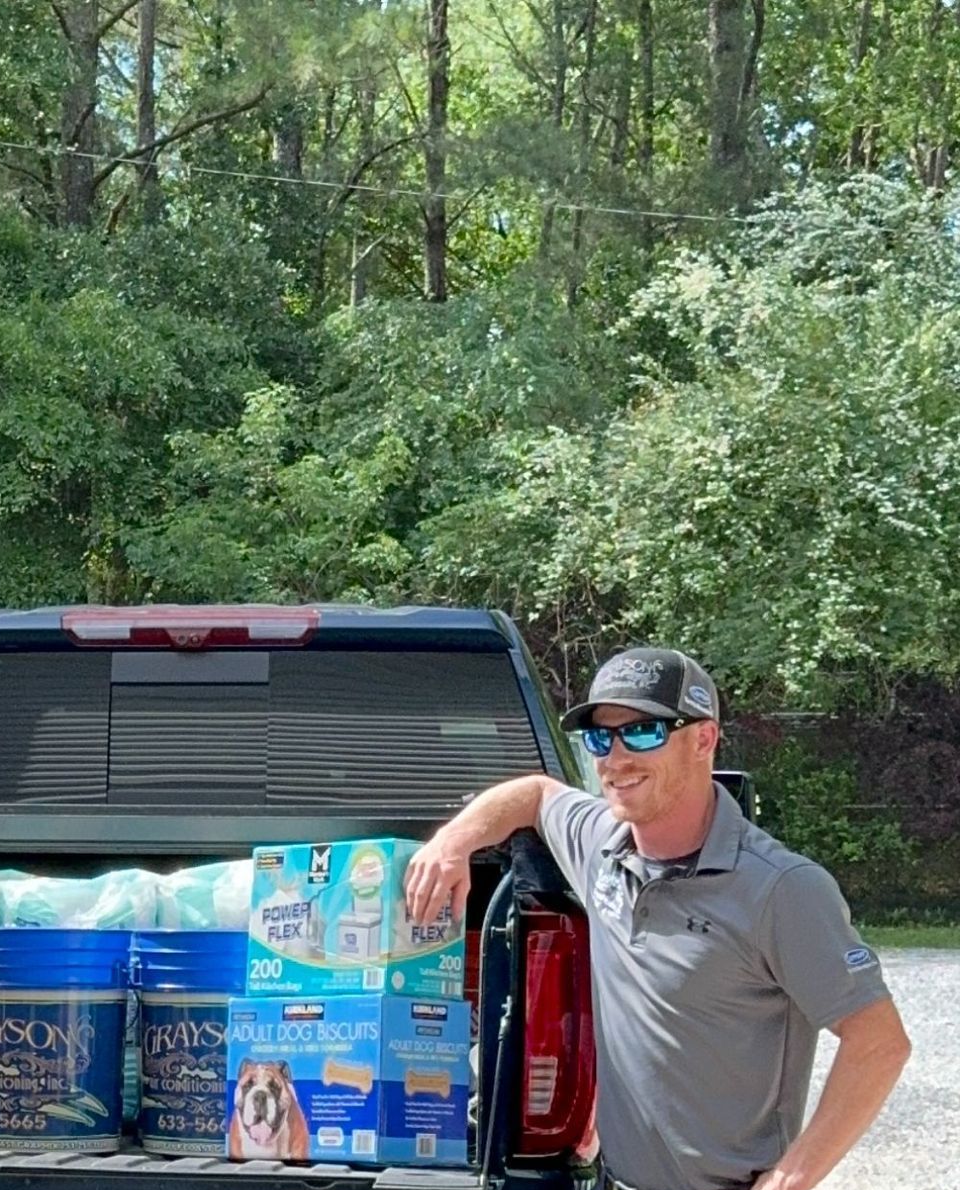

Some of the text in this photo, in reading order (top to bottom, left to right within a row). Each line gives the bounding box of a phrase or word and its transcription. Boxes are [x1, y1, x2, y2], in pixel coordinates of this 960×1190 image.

[262, 902, 313, 924] POWER
[267, 922, 303, 942] FLEX
[411, 925, 448, 943] FLEX
[249, 958, 283, 979] 200
[438, 954, 462, 971] 200
[144, 1021, 227, 1056] GRAYS
[231, 1021, 378, 1042] ADULT DOG BISCUITS
[157, 1113, 226, 1132] 633-56
